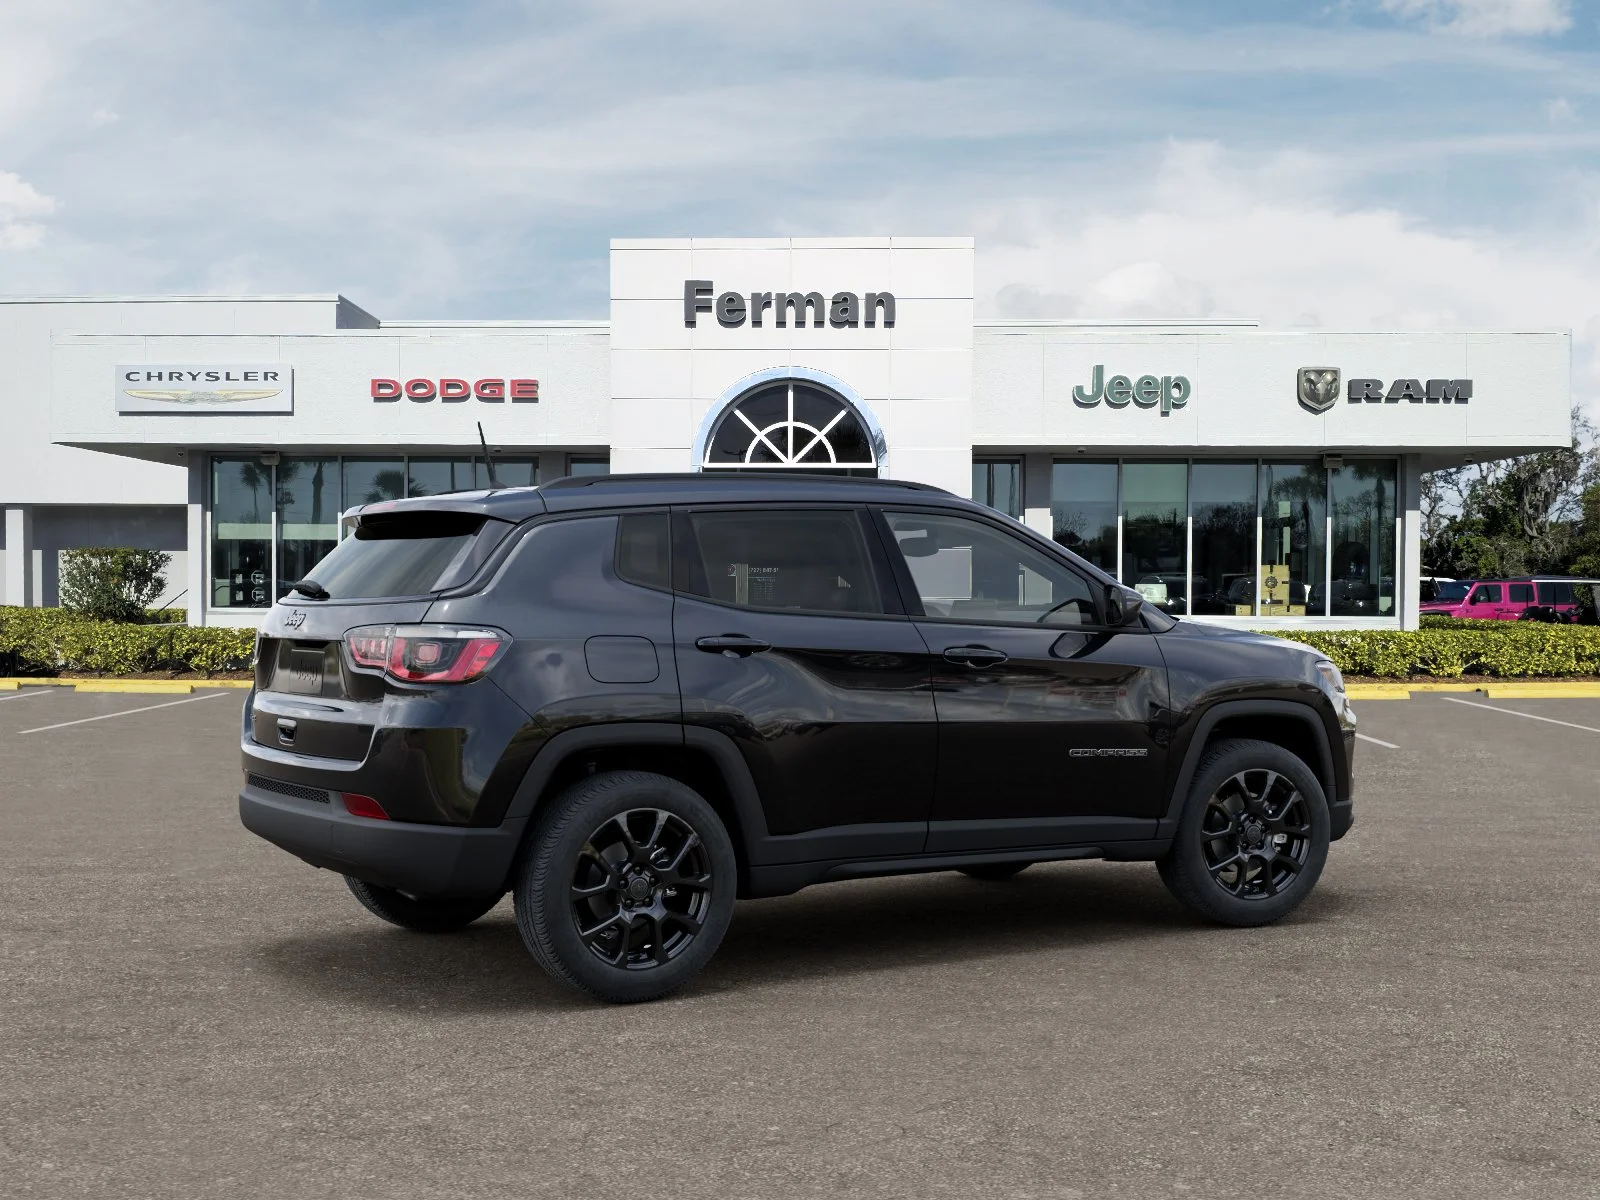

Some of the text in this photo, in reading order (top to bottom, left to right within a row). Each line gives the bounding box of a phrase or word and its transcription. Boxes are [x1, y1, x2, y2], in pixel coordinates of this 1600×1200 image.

[684, 280, 896, 326] Ferman
[125, 371, 280, 382] CHRYSLER
[1072, 364, 1191, 412] Jeep
[370, 378, 539, 401] DODGE
[1347, 378, 1473, 401] RAM
[284, 610, 307, 630] Jeep
[1069, 748, 1148, 757] COMPASS
